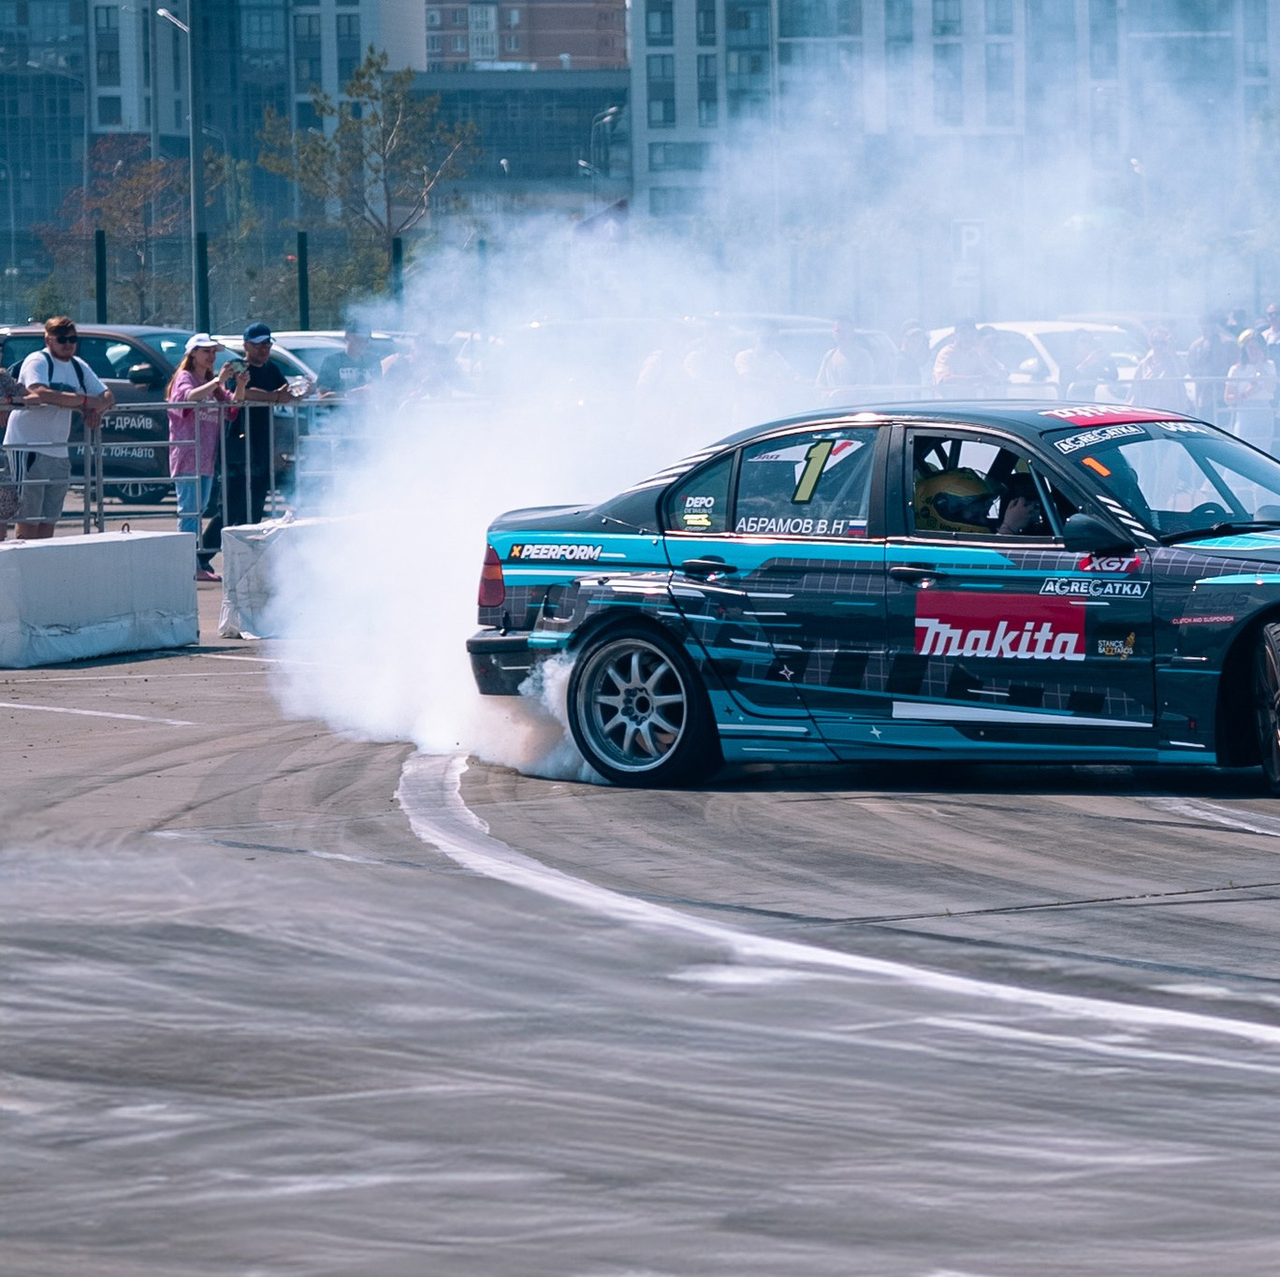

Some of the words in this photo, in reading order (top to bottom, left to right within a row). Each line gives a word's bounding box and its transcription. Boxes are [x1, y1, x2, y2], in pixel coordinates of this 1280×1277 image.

[1059, 424, 1140, 452] AGREGATKA
[791, 439, 836, 504] 1
[1081, 456, 1112, 478] 1
[685, 496, 715, 508] DEPO
[735, 517, 813, 534] АБРАМОВ
[1084, 556, 1138, 572] XGT
[1044, 578, 1143, 597] AGREGATKA
